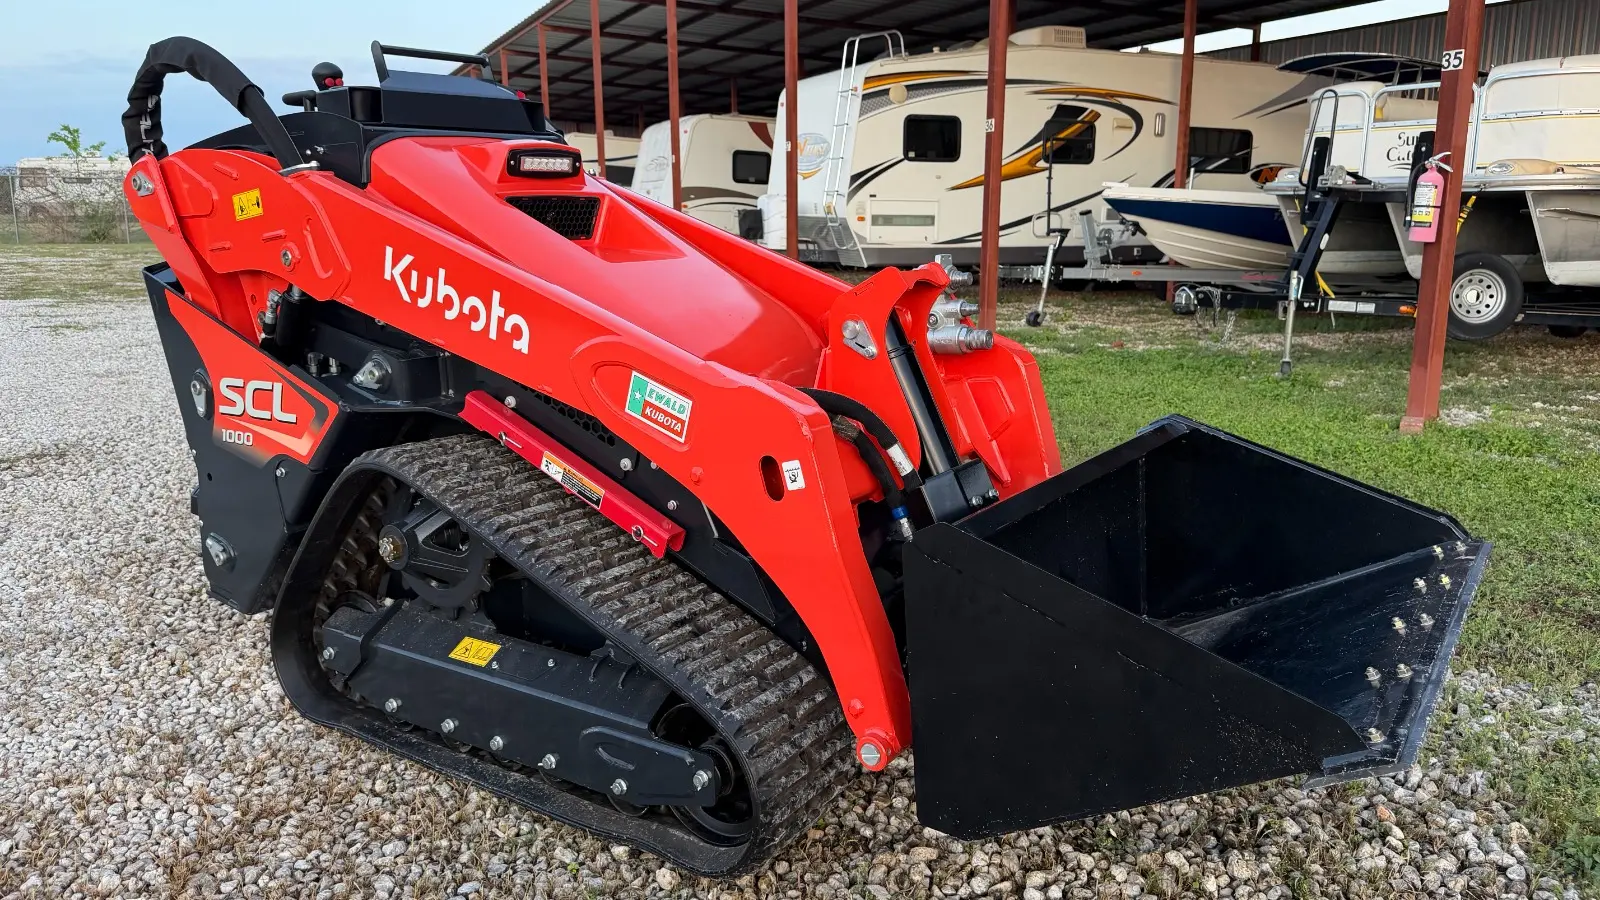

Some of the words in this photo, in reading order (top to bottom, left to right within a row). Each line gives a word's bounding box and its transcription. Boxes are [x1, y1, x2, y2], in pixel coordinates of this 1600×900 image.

[1442, 51, 1463, 69] 35
[384, 245, 530, 355] Kubota
[219, 377, 297, 424] SCL
[647, 387, 687, 415] EWALD
[645, 406, 682, 432] KUBOTA
[221, 429, 253, 446] 1000
